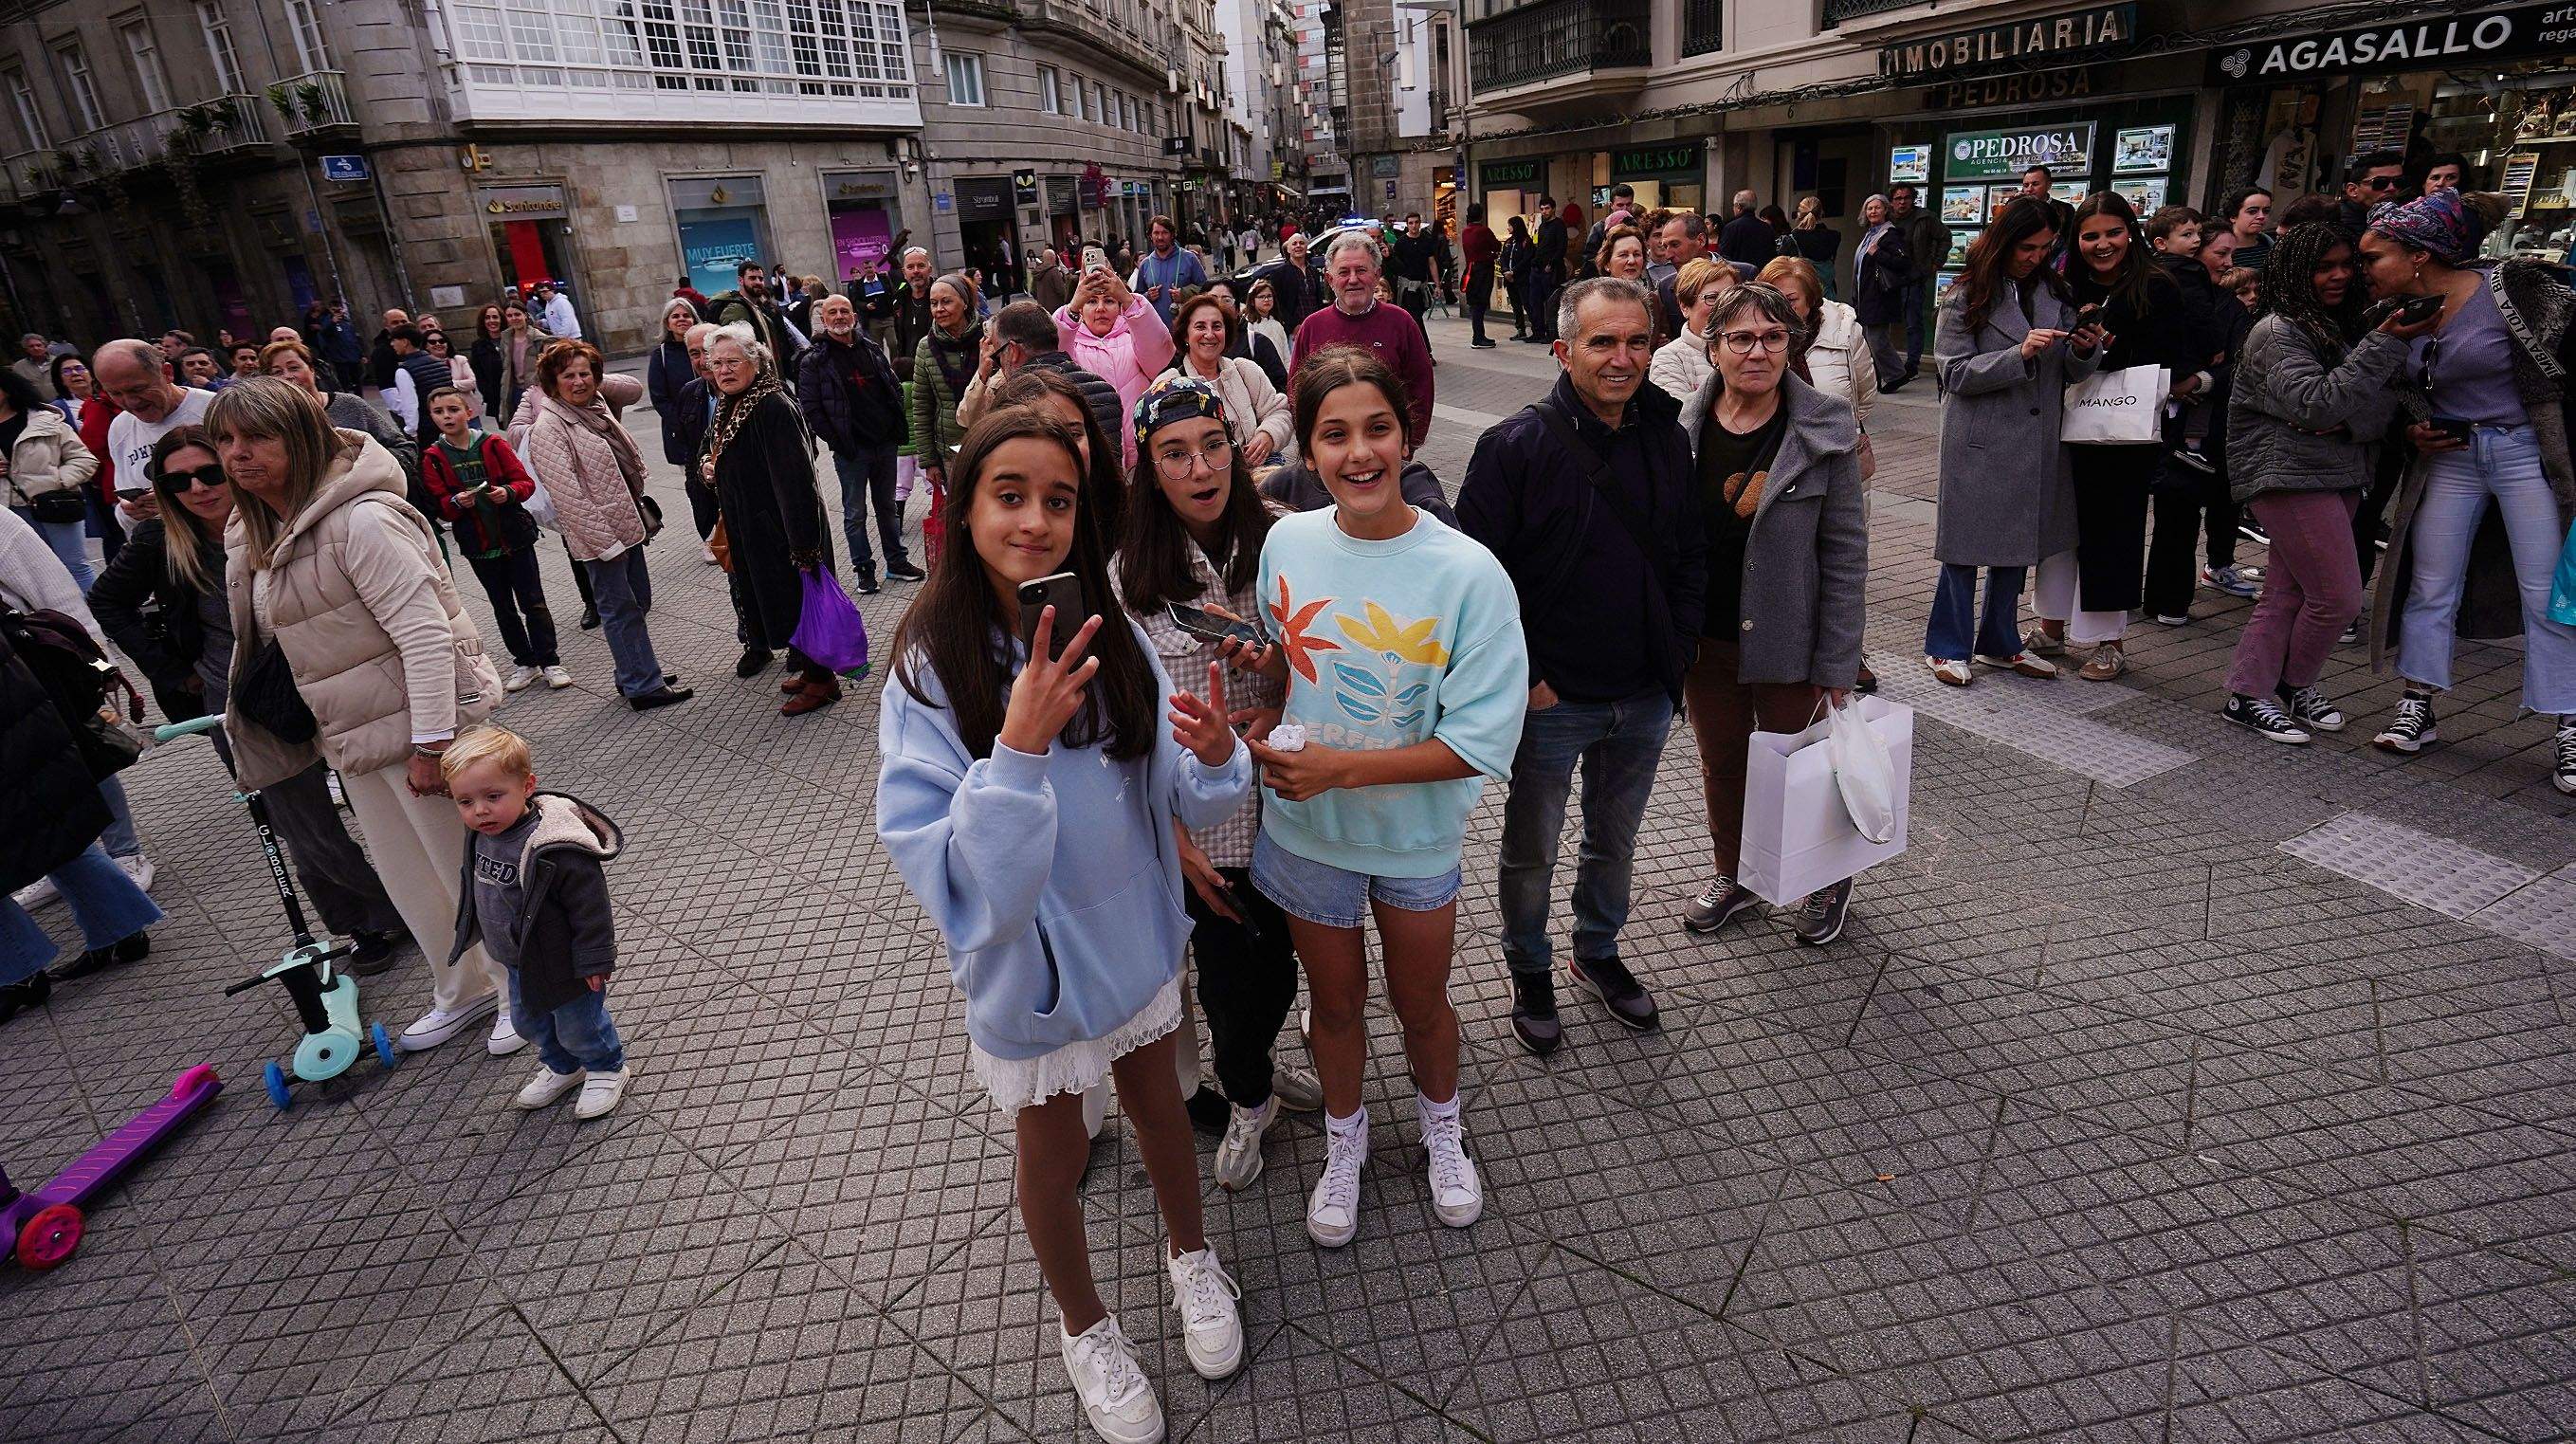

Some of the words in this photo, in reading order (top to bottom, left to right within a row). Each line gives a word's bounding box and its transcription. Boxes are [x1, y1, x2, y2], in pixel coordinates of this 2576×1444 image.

[2542, 6, 2576, 25] art
[2259, 15, 2513, 74] AGASALLO
[1947, 64, 2091, 107] PEDROSA
[1971, 132, 2079, 159] PEDROSA
[1619, 149, 1690, 173] ARESSO
[1486, 165, 1533, 182] ARESSO
[503, 200, 562, 213] Santande
[685, 247, 712, 263] MUY
[714, 242, 756, 258] FUERTE
[2499, 299, 2527, 333] LOLA
[2078, 395, 2137, 408] MANGO
[258, 824, 294, 898] GLOBBER
